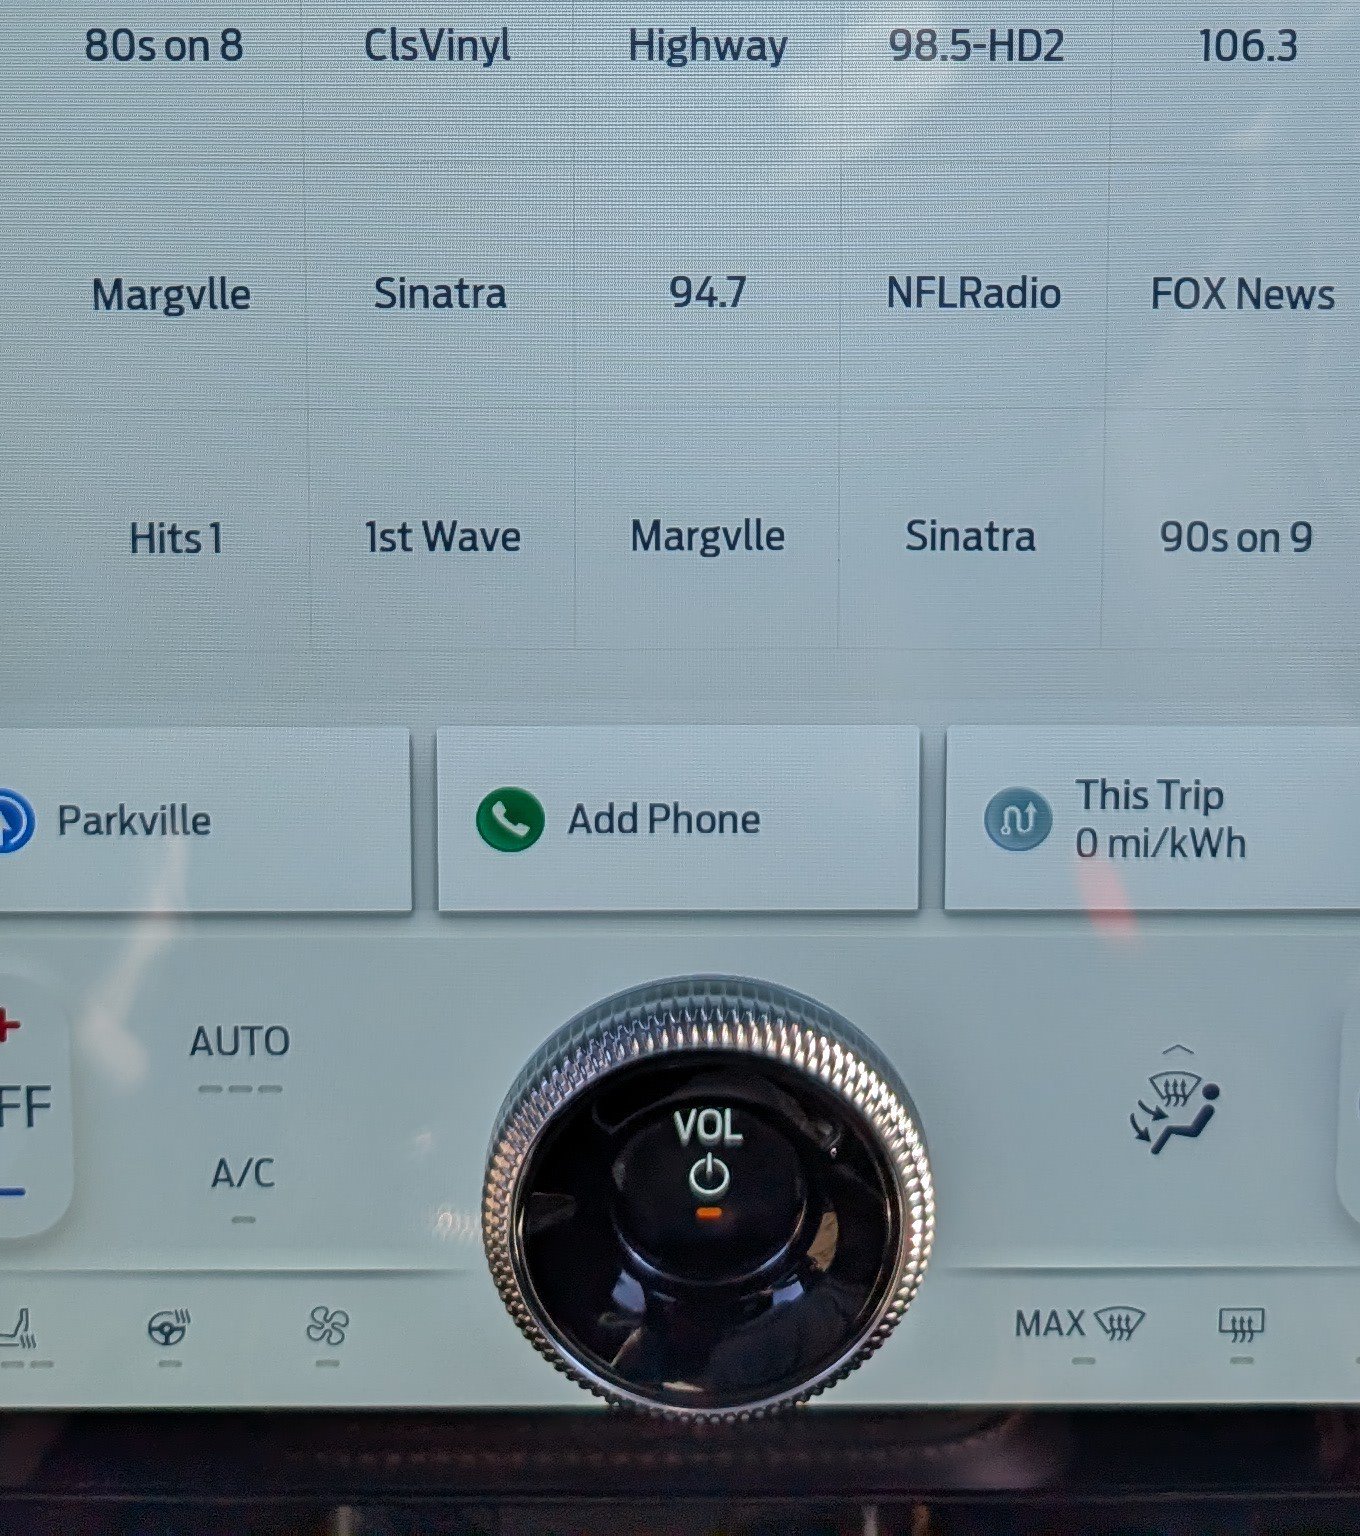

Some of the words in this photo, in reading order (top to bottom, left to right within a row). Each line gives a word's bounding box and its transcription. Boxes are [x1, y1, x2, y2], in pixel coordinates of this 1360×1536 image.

[85, 27, 157, 62] 80s
[164, 36, 210, 62] on
[219, 27, 244, 62] 8
[364, 26, 511, 68] ClsVinyl
[629, 26, 788, 69] Highway
[889, 27, 1064, 63] 98.5-HD2
[1199, 28, 1298, 63] 106.3
[92, 275, 251, 318] Margvlle
[374, 276, 507, 310] Sinatra
[669, 274, 747, 309] 94.7
[887, 274, 1062, 310] NFLRadio
[1152, 276, 1226, 310] FOX
[1237, 276, 1336, 311] News
[130, 521, 202, 555] Hits
[209, 521, 221, 554] 1
[365, 520, 413, 553] 1st
[421, 519, 521, 553] Wave
[631, 517, 786, 559] Margvlle
[906, 518, 1037, 552] Sinatra
[1160, 520, 1229, 553] 90s
[1236, 528, 1281, 554] on
[1290, 520, 1313, 554] 9
[1075, 777, 1150, 811] This
[1156, 778, 1225, 818] Trip
[58, 803, 211, 837] Parkville
[567, 801, 639, 835] Add
[648, 801, 761, 835] Phone
[1108, 826, 1247, 859] mi/kWh
[189, 1025, 290, 1057] AUTO
[673, 1107, 744, 1144] VOL
[210, 1157, 275, 1189] A/C
[1015, 1309, 1086, 1337] MAX
